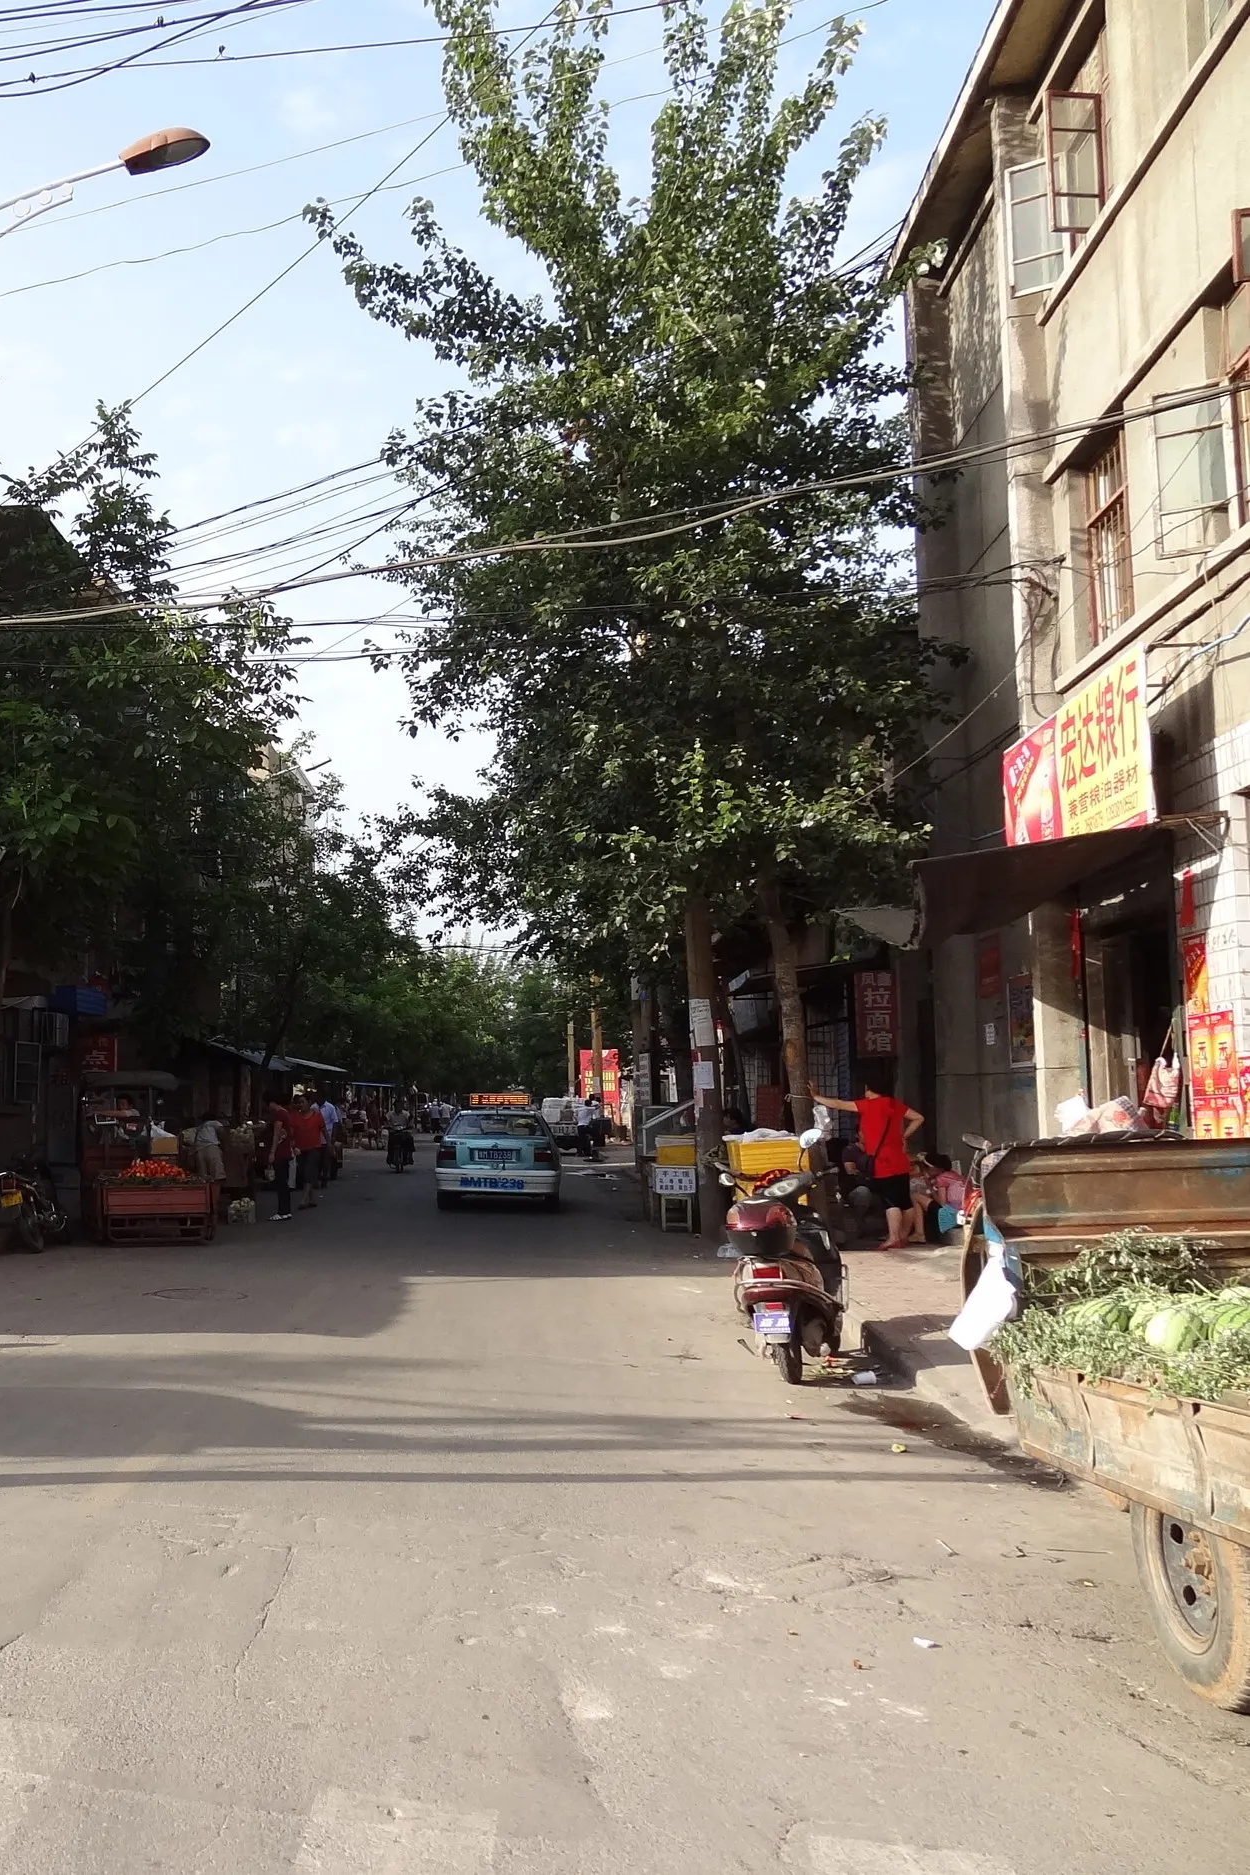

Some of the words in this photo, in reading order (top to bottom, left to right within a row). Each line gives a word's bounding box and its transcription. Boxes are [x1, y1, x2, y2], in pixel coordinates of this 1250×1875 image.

[1061, 659, 1139, 793] 宏达粮行
[863, 988, 894, 1053] 拉面馆
